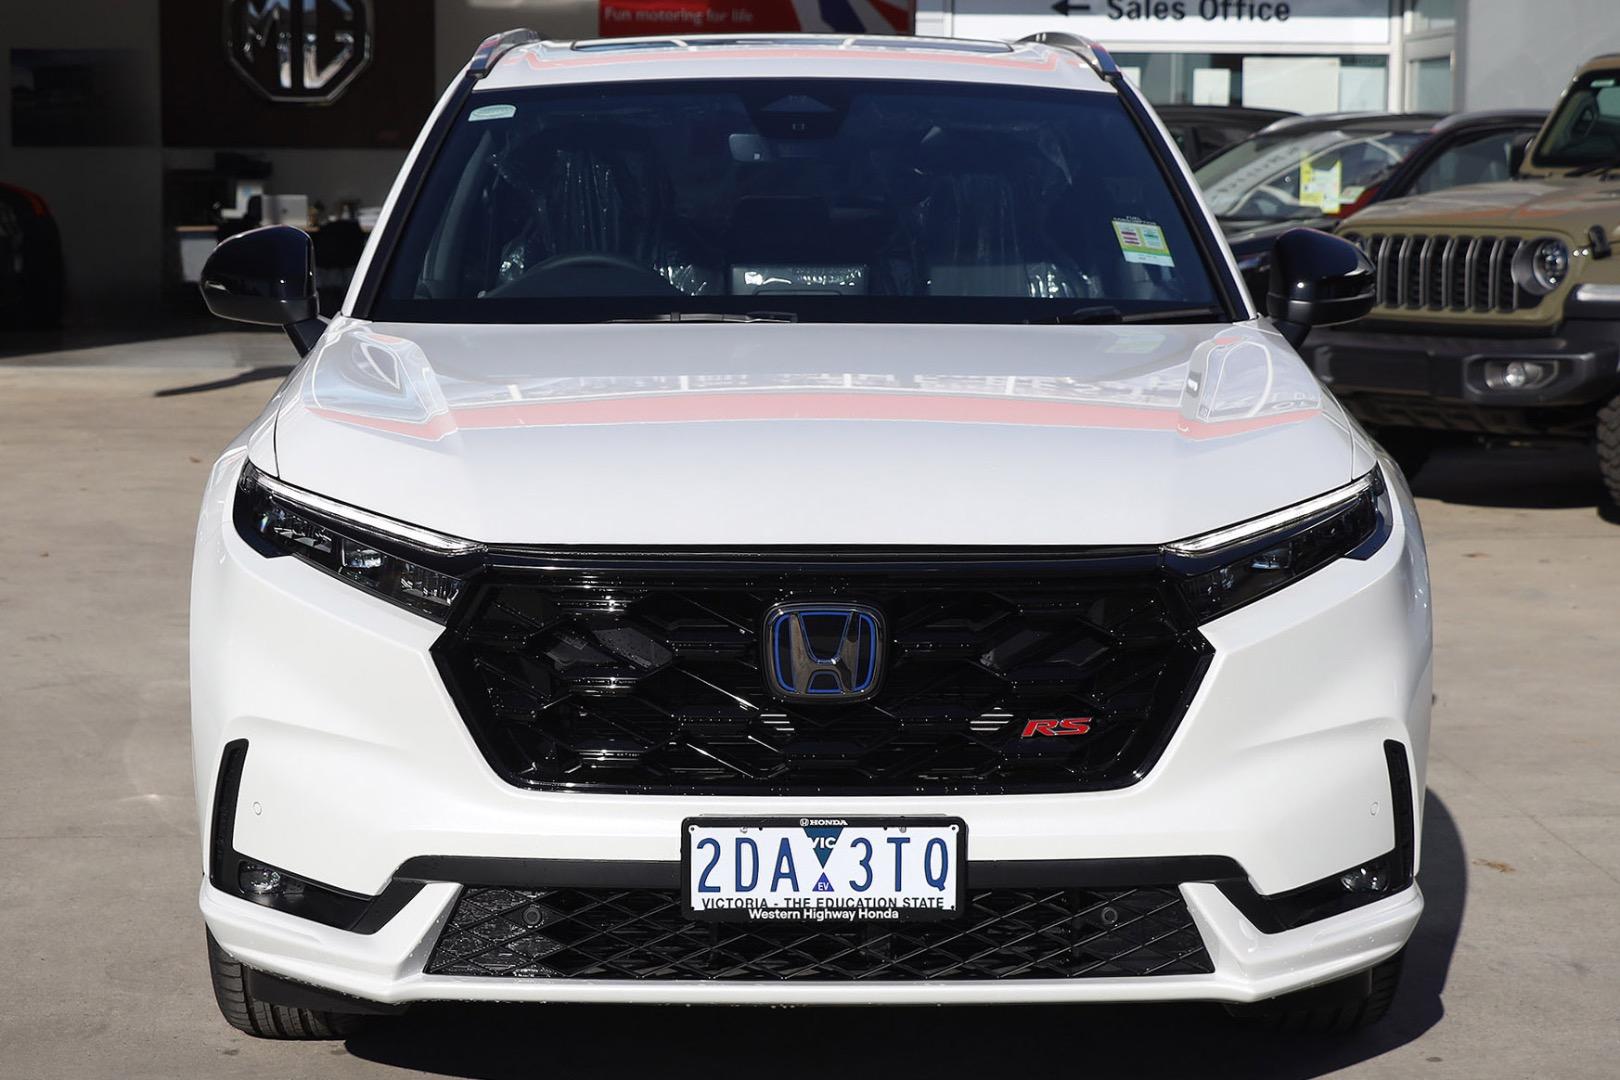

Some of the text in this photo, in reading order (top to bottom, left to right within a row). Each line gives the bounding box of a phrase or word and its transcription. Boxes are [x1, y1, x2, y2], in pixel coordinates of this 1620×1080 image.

[604, 6, 753, 27] Fun motoring for life
[1107, 0, 1290, 21] Sales Office
[242, 0, 355, 89] MG
[1021, 717, 1092, 738] RS
[808, 837, 837, 849] VIC
[696, 837, 949, 893] 2DA 3TQ
[817, 881, 830, 891] EV
[701, 898, 769, 909] VICTORIA
[784, 898, 812, 908] THE
[816, 897, 898, 908] EDUCATION
[902, 897, 944, 908] STATE
[748, 908, 899, 922] Western Highway Honda
